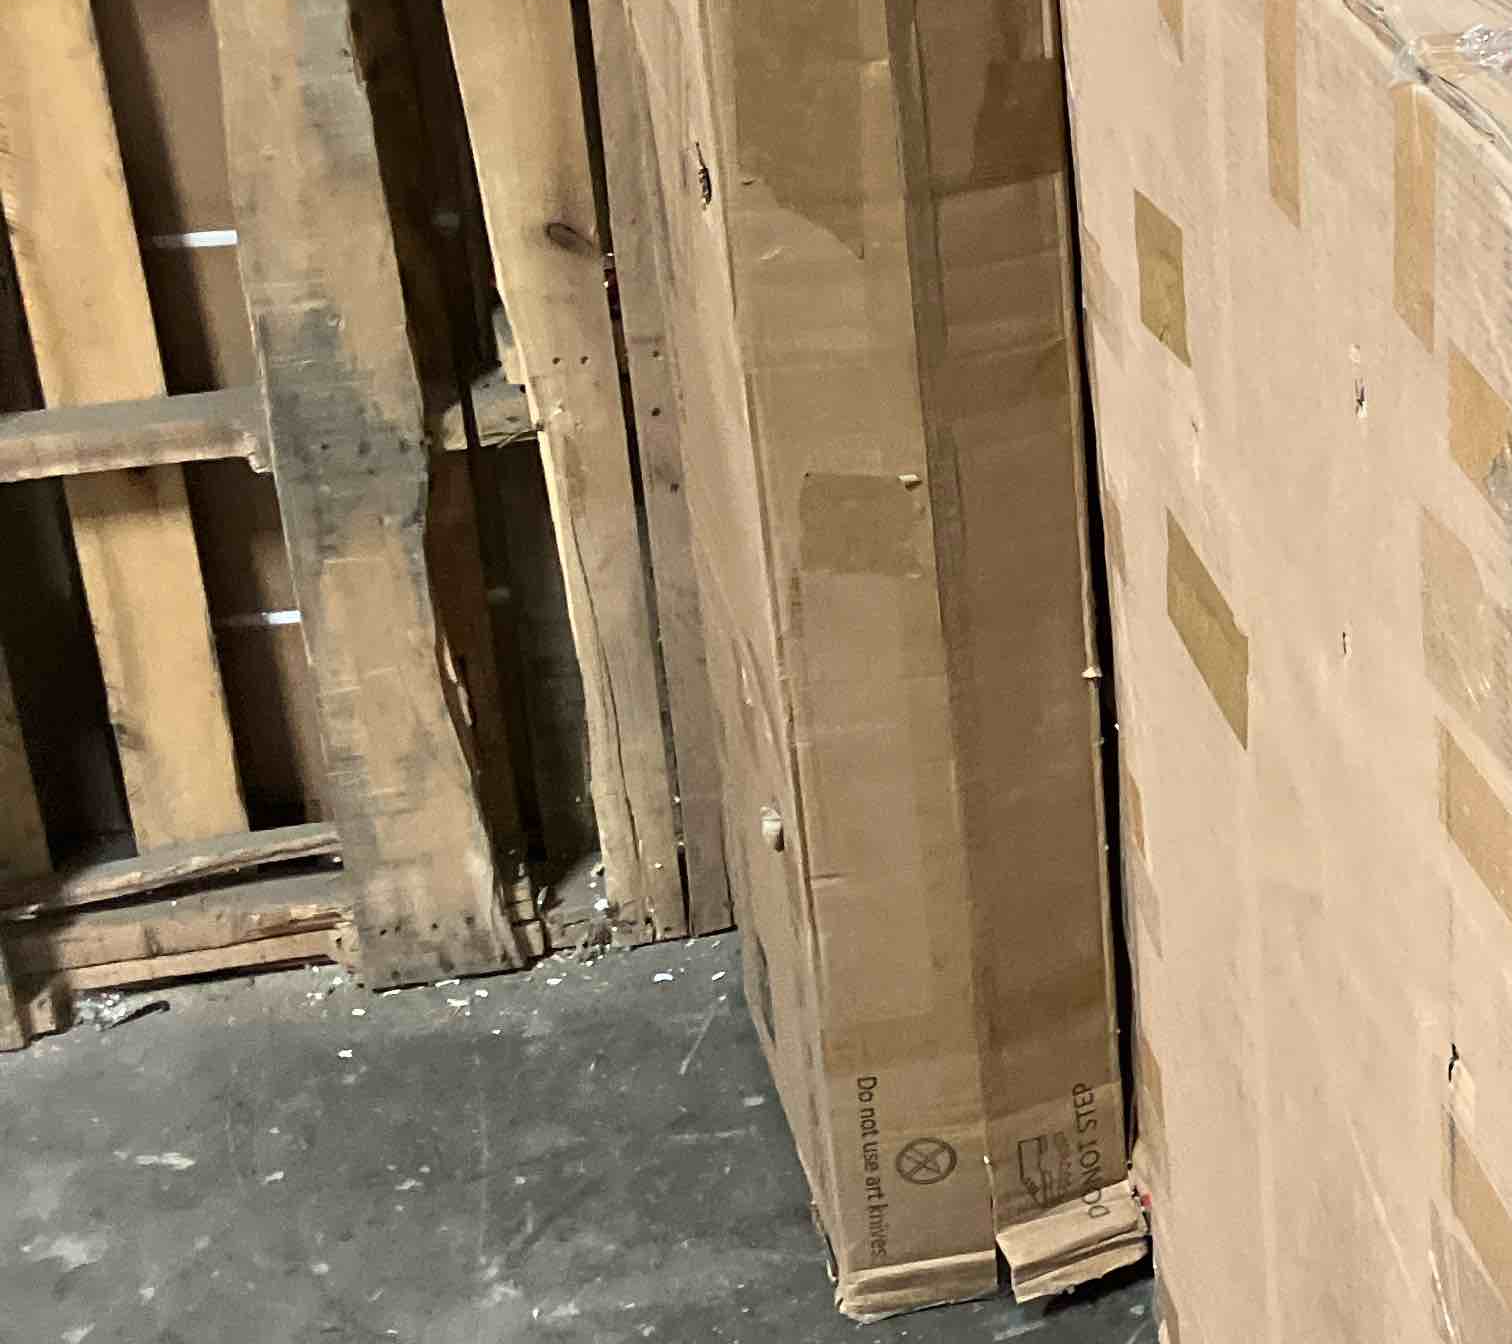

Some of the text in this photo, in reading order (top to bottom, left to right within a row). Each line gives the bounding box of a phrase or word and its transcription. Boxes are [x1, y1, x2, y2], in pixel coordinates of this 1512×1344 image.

[1071, 1082, 1098, 1133] STEP
[857, 1076, 889, 1257] Do not use art knives
